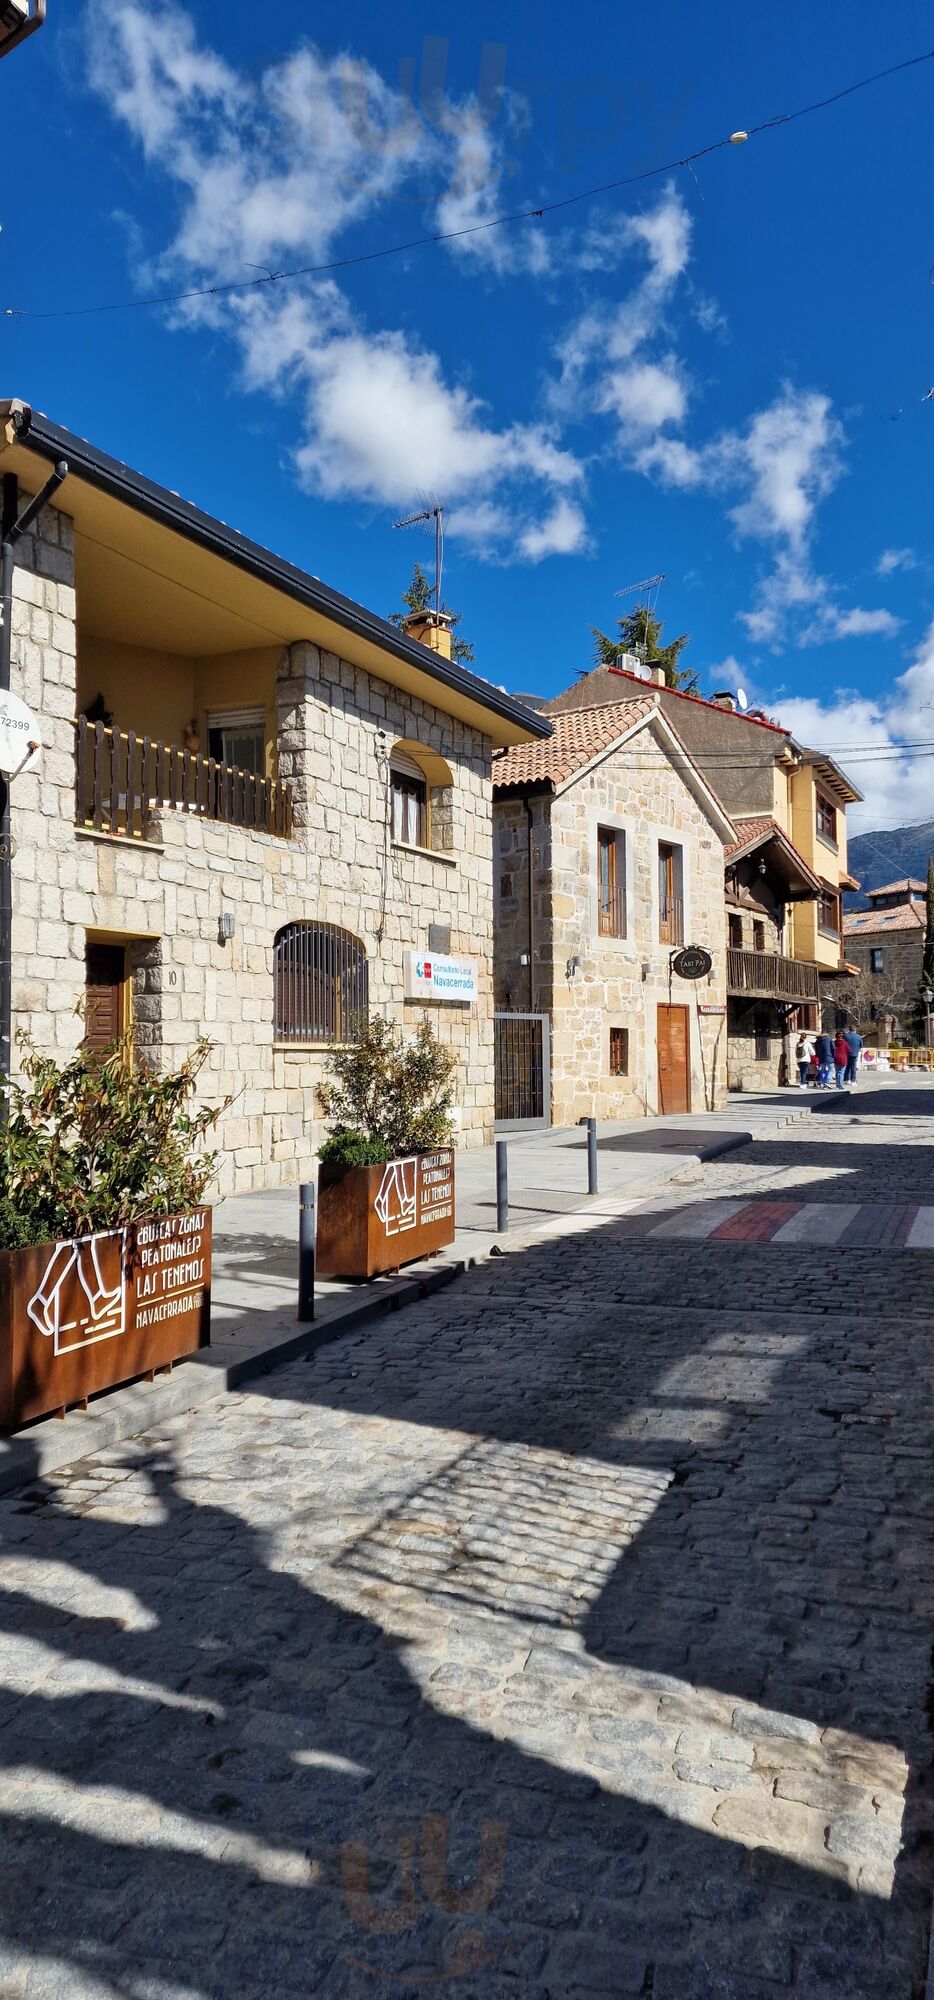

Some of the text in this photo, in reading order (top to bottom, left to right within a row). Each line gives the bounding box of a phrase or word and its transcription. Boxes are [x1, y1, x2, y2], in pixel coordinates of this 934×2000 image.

[168, 970, 177, 986] 10
[460, 966, 472, 975] Local
[433, 975, 474, 989] Navacerrada
[178, 1213, 206, 1234] ZONAS
[141, 1236, 202, 1268] PEATONALES?
[136, 1258, 205, 1299] LAS TENEMOS
[135, 1295, 193, 1329] NAVACERRADA
